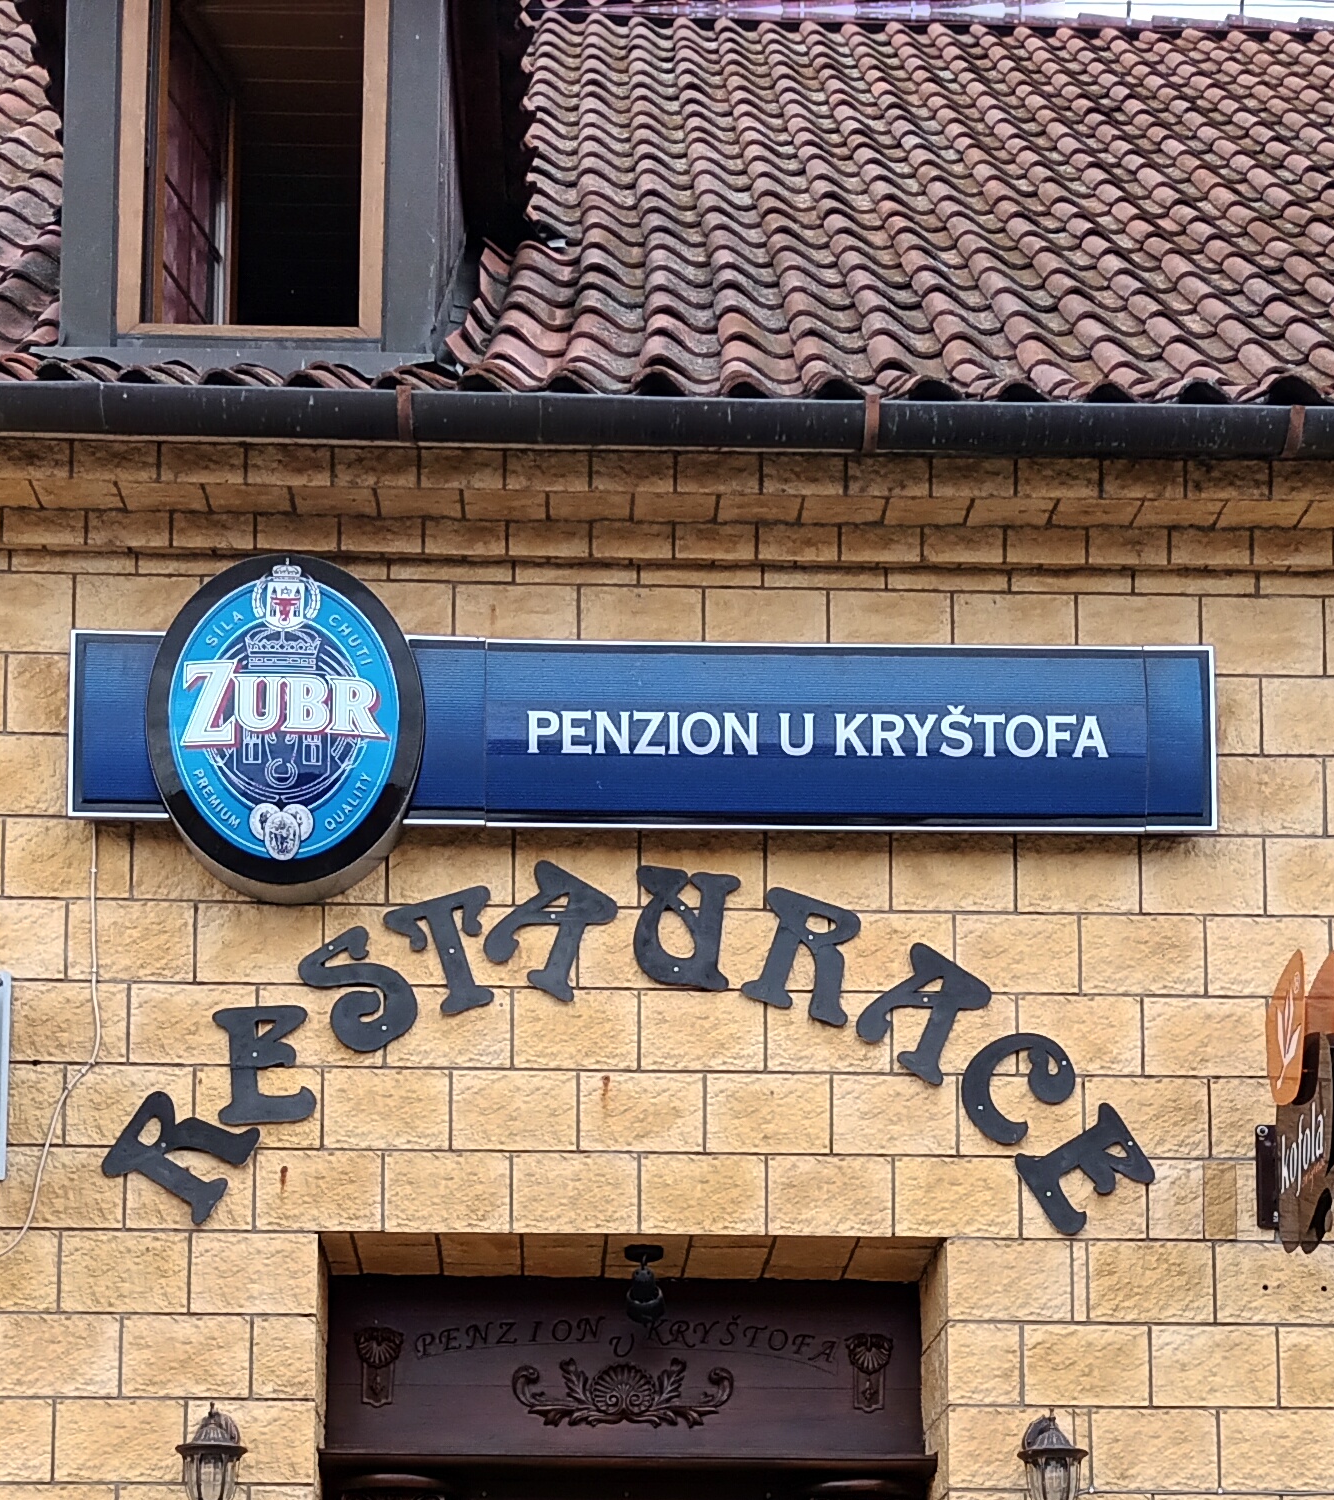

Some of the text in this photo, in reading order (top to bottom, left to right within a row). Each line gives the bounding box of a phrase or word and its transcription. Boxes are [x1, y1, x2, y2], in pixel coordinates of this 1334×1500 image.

[205, 610, 373, 666] SÍLA CHUTI
[180, 658, 389, 746] ZUBR
[526, 705, 1110, 758] PENZION U KRYŠTOFA
[193, 768, 373, 831] PREMIUM QUALITY
[101, 860, 1155, 1236] RESTAURACE
[1280, 1101, 1324, 1197] kofola
[415, 1313, 839, 1364] PENZION U KRYŠTOFA
